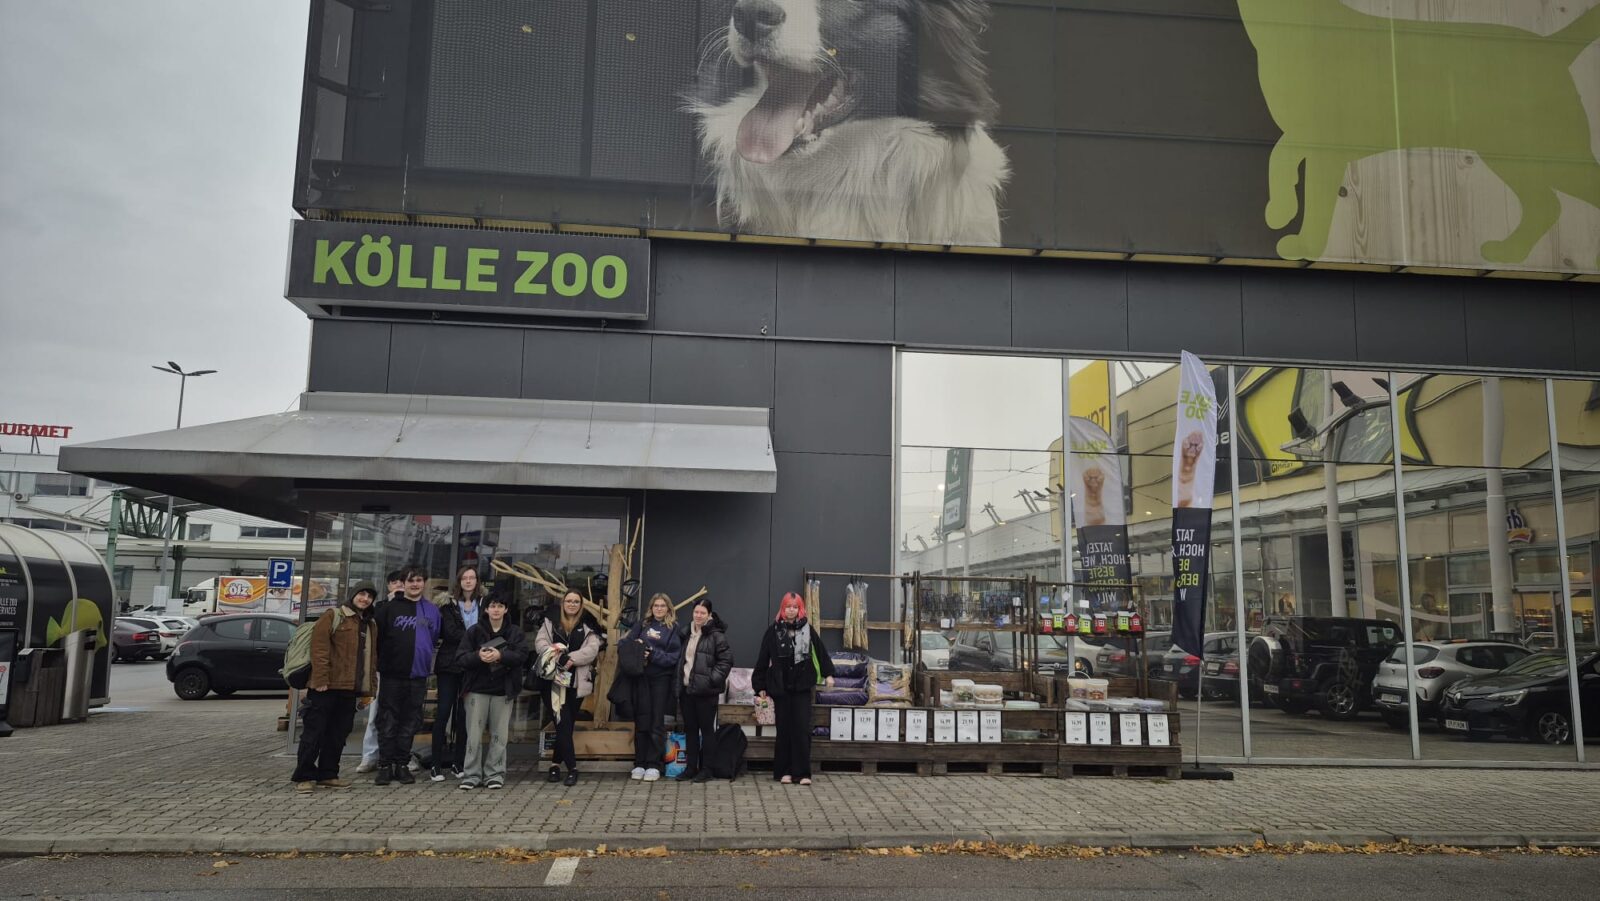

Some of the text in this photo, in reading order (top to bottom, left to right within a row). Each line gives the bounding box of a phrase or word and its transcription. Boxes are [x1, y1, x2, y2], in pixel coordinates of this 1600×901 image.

[313, 234, 628, 299] KÖLLE ZOO
[273, 562, 288, 579] P
